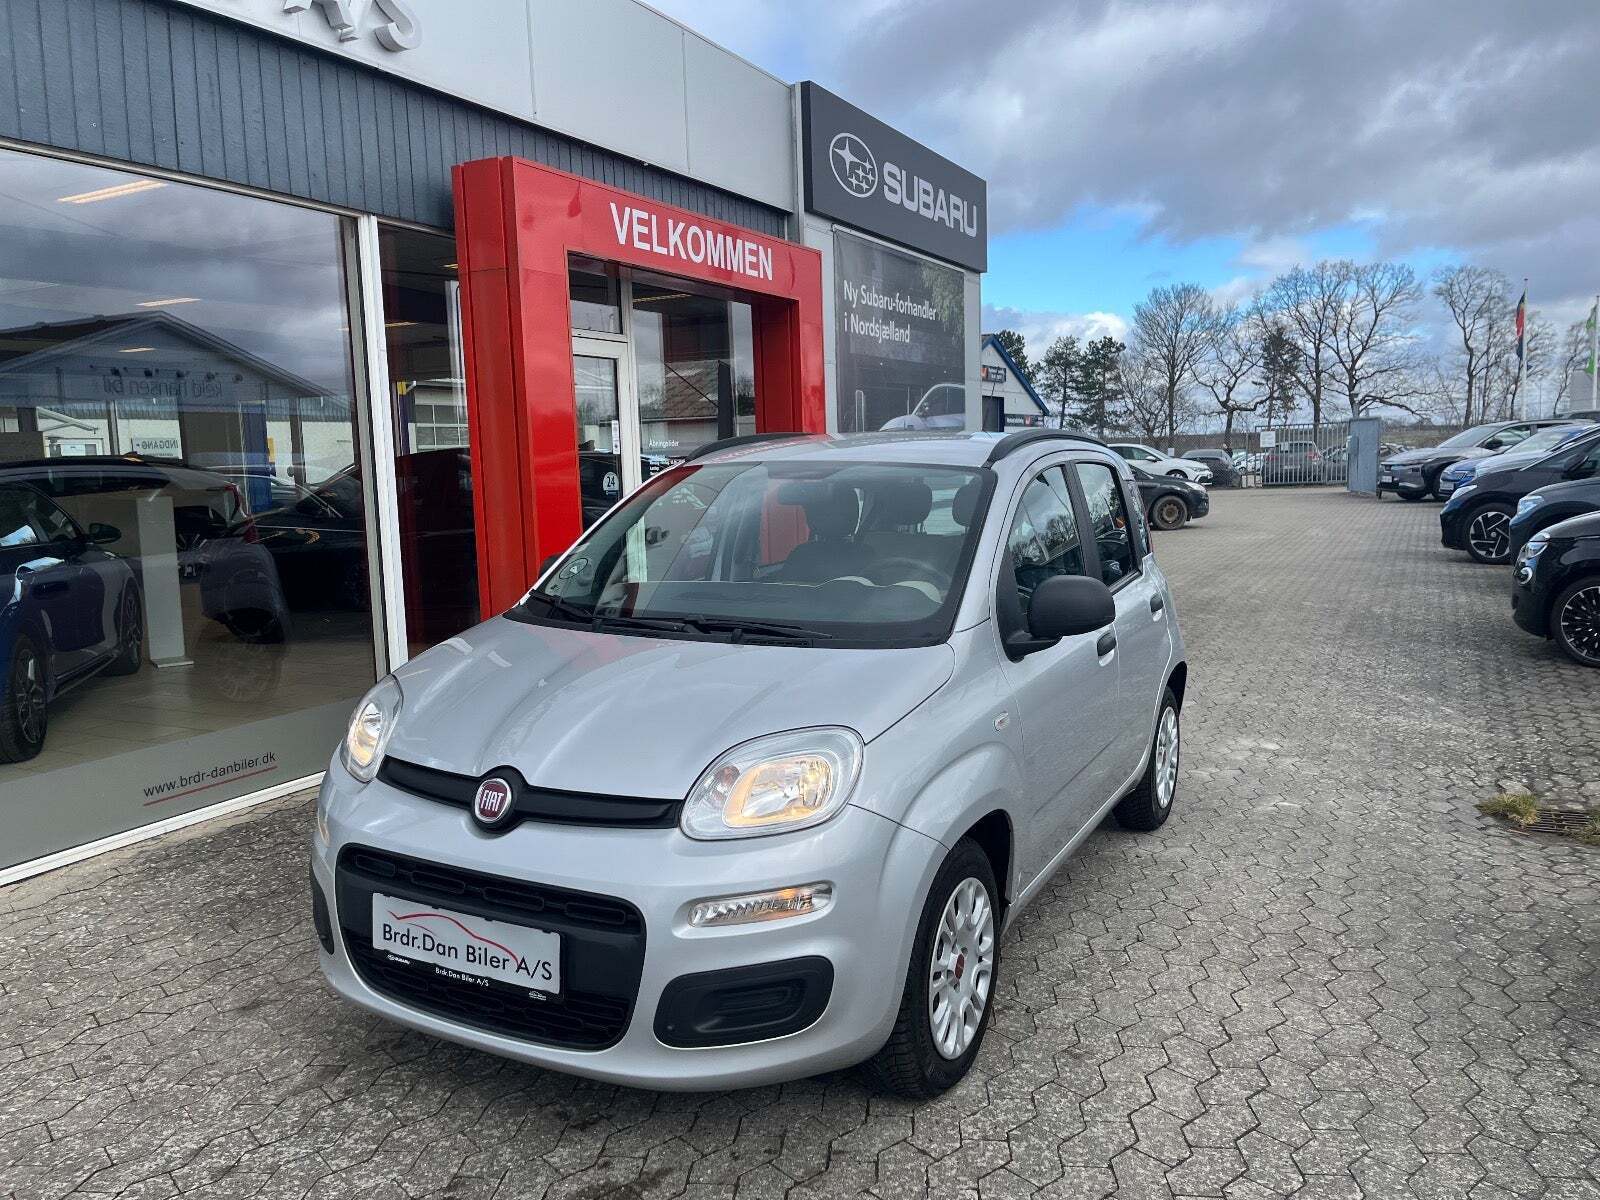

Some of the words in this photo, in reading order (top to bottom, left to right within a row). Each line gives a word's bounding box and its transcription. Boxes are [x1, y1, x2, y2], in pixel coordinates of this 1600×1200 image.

[883, 161, 977, 238] SUBARU
[609, 201, 774, 281] VELKOMMEN
[843, 279, 859, 309] Ny
[861, 284, 937, 321] Subaru-forhandler
[844, 311, 848, 333] i
[850, 313, 911, 344] Nordsjælland
[606, 475, 616, 488] 24
[143, 751, 277, 798] www.brdr-danbiler.dk
[480, 789, 505, 812] FIAT
[382, 922, 459, 960] Brdr.Dan
[466, 944, 510, 971] Biler
[515, 955, 553, 981] A/S
[435, 966, 461, 979] Brdr.Dan
[461, 973, 475, 983] Biler
[476, 977, 490, 988] A/S
